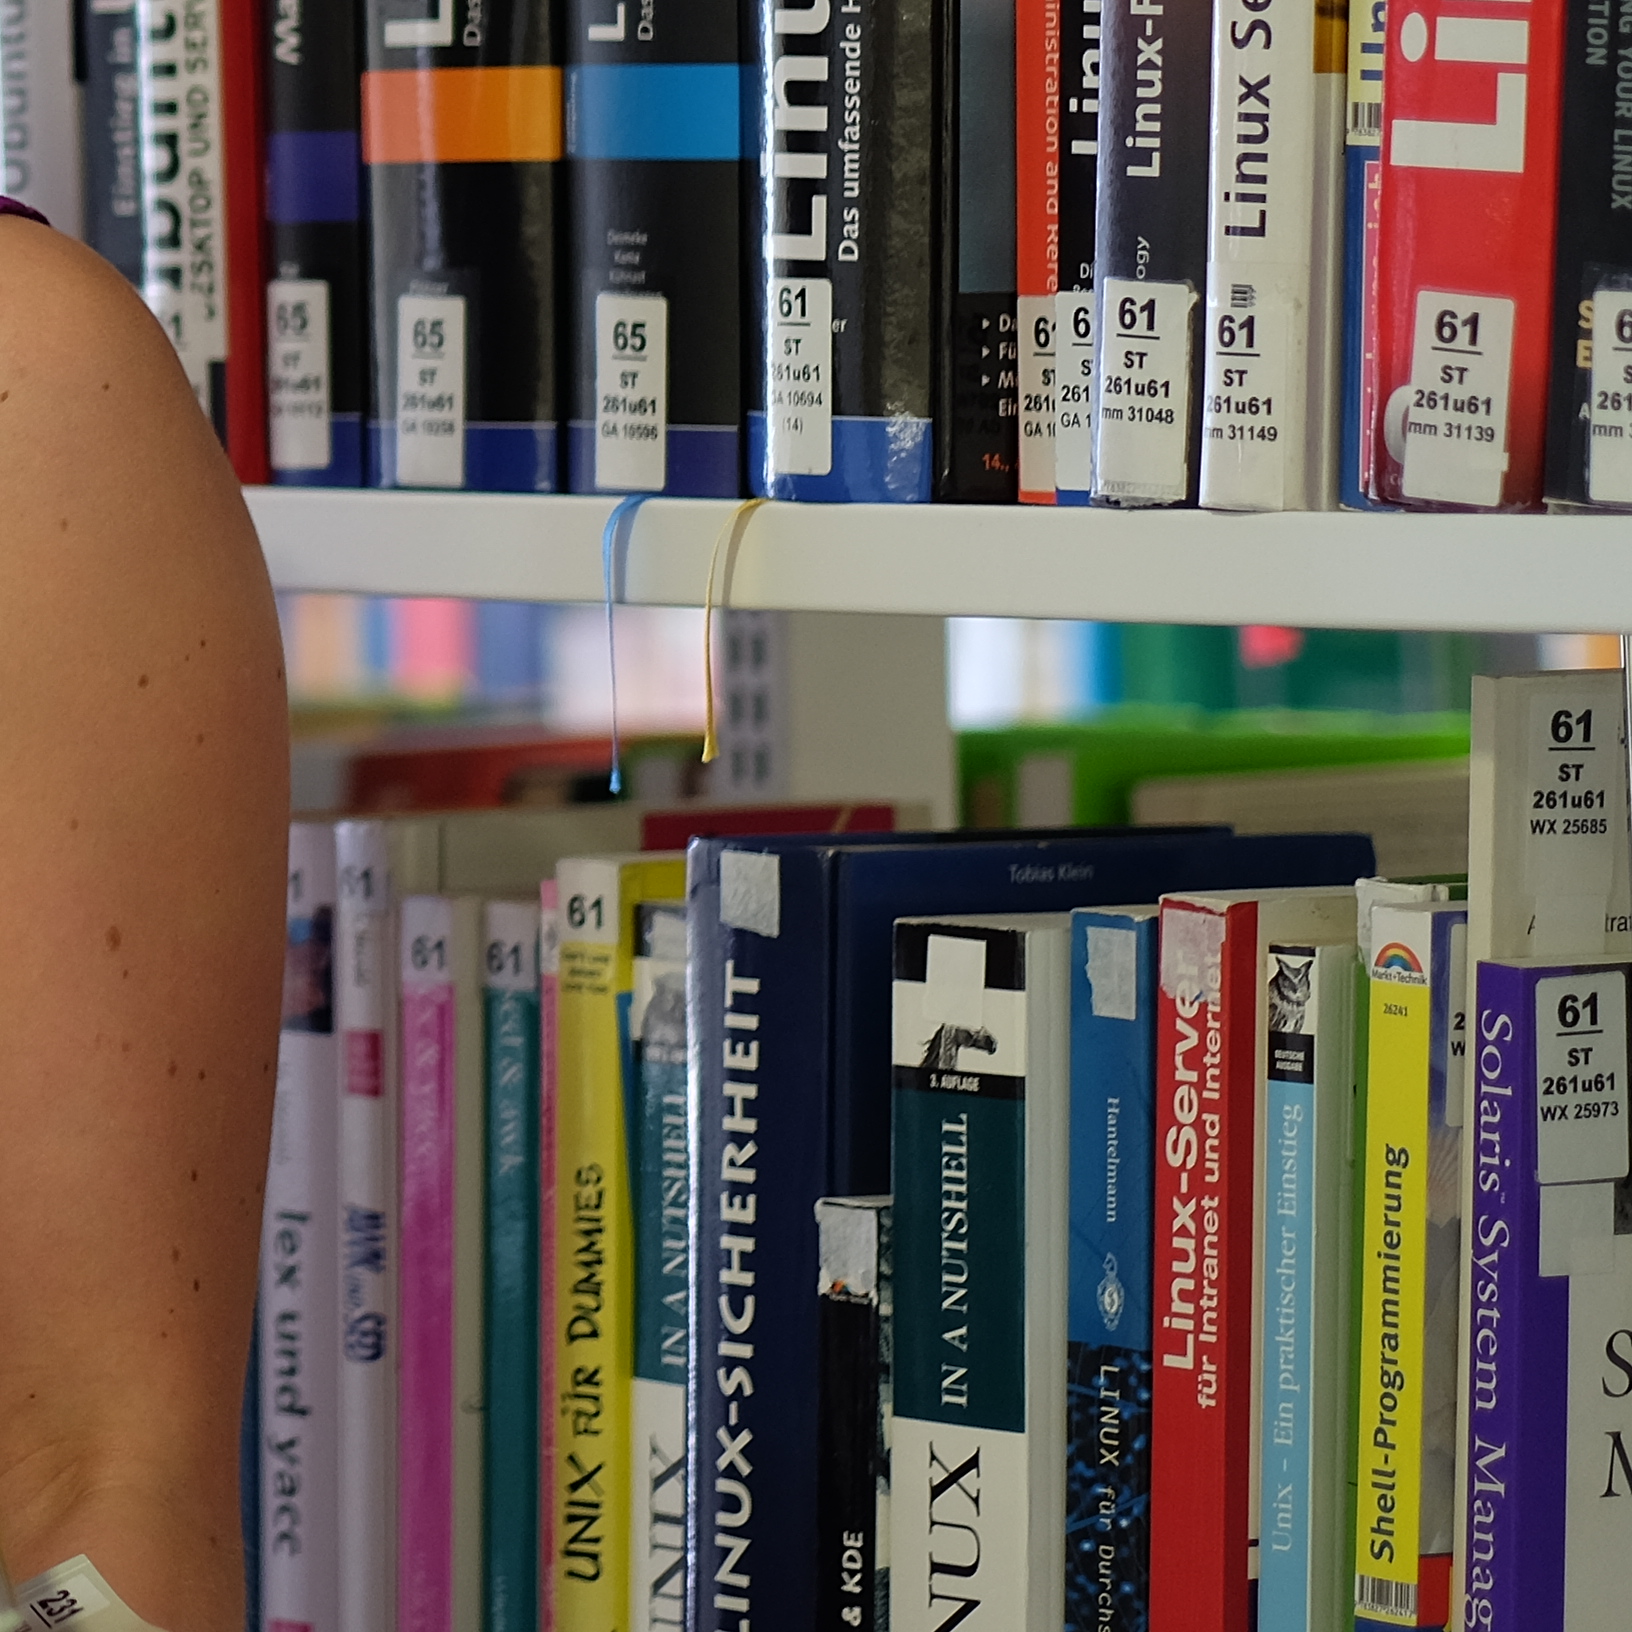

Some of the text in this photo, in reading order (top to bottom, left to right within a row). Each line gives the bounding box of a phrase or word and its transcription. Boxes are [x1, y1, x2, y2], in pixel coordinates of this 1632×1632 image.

[836, 22, 863, 197] umfassende
[1223, 72, 1272, 240] Linux
[1609, 128, 1632, 209] LINUX
[837, 207, 861, 263] Das
[778, 285, 808, 319] 61
[1117, 296, 1157, 333] 61
[412, 318, 446, 352] 65
[612, 321, 648, 353] 65
[1216, 314, 1256, 350] 61
[1434, 308, 1480, 347] 61
[783, 339, 802, 357] ST
[1123, 350, 1148, 370] ST
[619, 371, 640, 390] ST
[1104, 375, 1171, 399] 261u61
[1222, 369, 1248, 388] ST
[1439, 364, 1469, 386] ST
[1127, 405, 1175, 425] 31048
[1412, 388, 1493, 417] 261u61
[1228, 423, 1278, 444] 31149
[1407, 420, 1496, 443] mm 31139
[1549, 708, 1593, 744] 61
[1557, 763, 1585, 783] ST
[1532, 789, 1606, 810] 261u61
[1529, 818, 1608, 835] WX 25685
[1008, 860, 1095, 886] Tobias Klein
[566, 893, 605, 930] 61
[486, 938, 524, 978] 61
[1370, 969, 1429, 987] Markt+Technik
[1557, 991, 1599, 1029] 61
[1566, 1046, 1594, 1067] ST
[939, 1073, 981, 1093] AUFLAGE
[1542, 1071, 1616, 1096] 261u61
[1540, 1100, 1620, 1122] WX 25973
[1106, 1096, 1121, 1224] Hantelmann
[1201, 1112, 1222, 1184] und
[940, 1112, 970, 1410] IN A NUTSHELL
[1197, 1194, 1220, 1344] Intranet
[1271, 1103, 1304, 1556] Unix Ein praktischer Einstieg
[1470, 1214, 1512, 1411] System
[1369, 1142, 1410, 1564] Shell-Programmierung
[560, 1161, 606, 1584] UNIX FÜR DUMMIES
[1196, 1355, 1218, 1410] für
[1099, 1364, 1121, 1467] LINUX
[266, 1310, 313, 1558] und yacc
[1097, 1485, 1117, 1532] für
[840, 1529, 865, 1595] KDE
